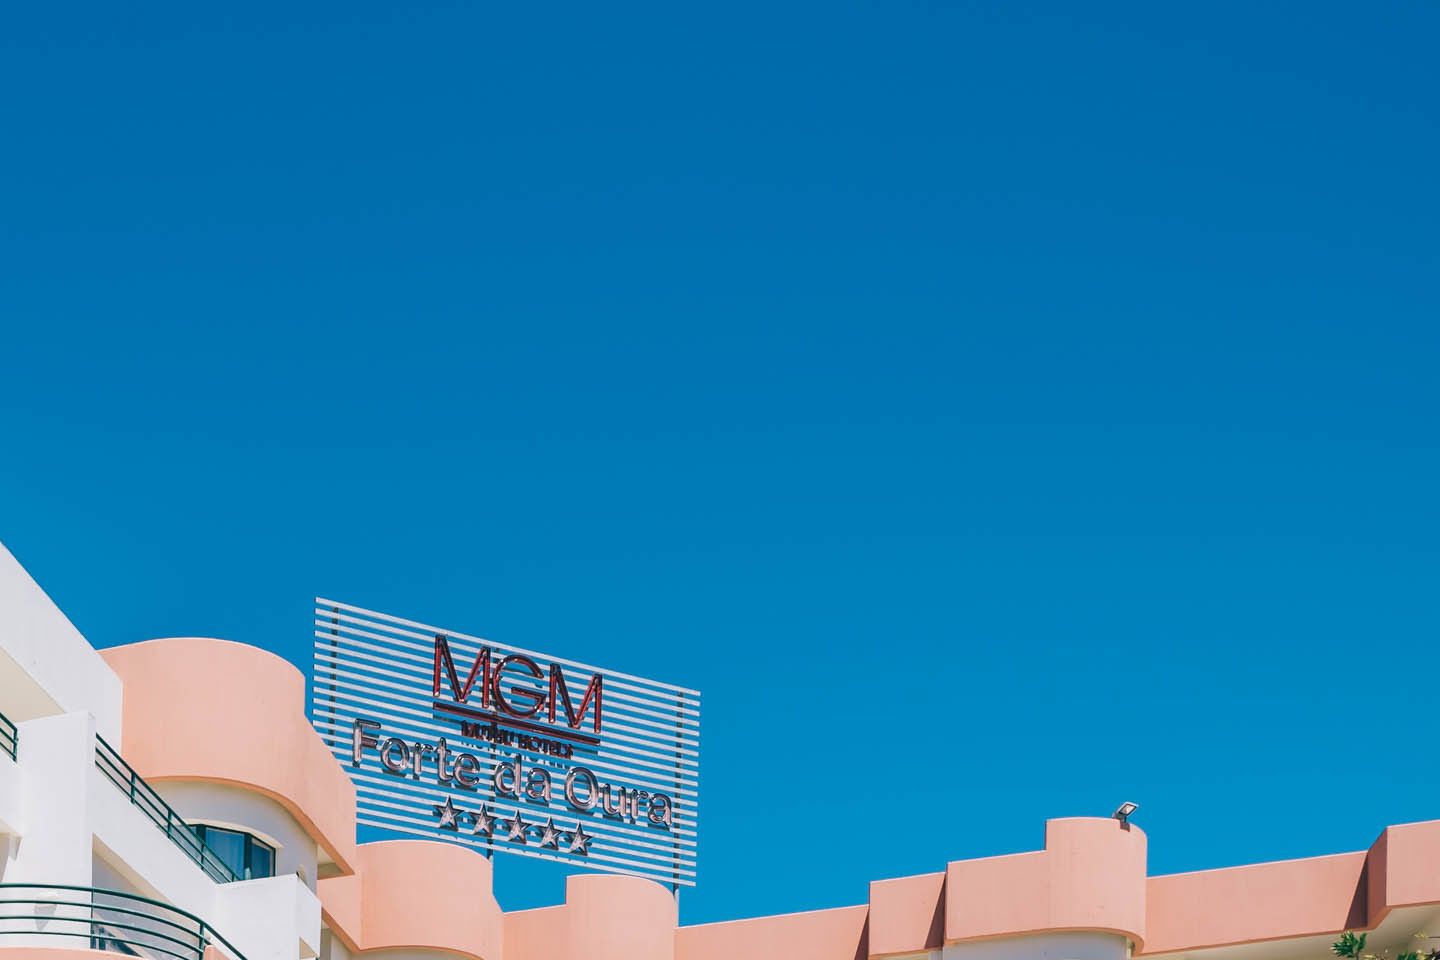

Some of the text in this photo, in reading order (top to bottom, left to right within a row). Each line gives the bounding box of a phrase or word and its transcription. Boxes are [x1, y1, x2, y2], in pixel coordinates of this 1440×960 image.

[432, 634, 602, 734] MGM
[352, 718, 672, 828] Forte da Oura
